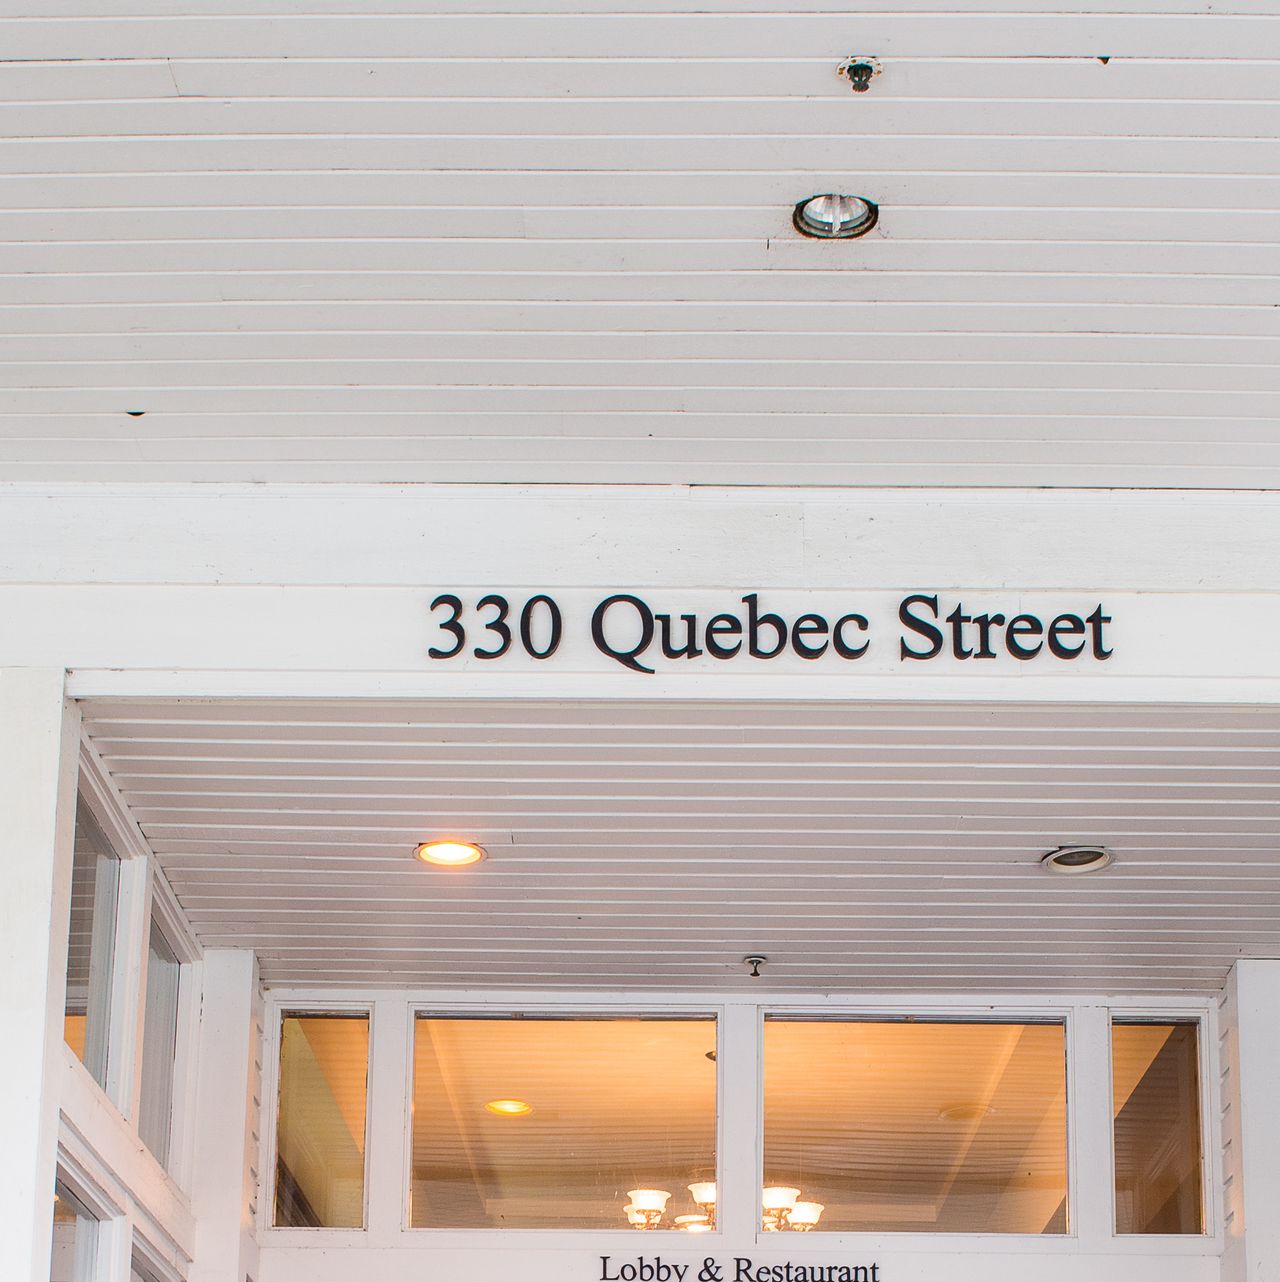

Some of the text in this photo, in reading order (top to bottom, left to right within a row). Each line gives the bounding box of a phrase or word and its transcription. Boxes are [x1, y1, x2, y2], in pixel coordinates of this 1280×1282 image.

[427, 593, 1114, 675] 330 Quebec Street
[697, 1257, 724, 1282] &
